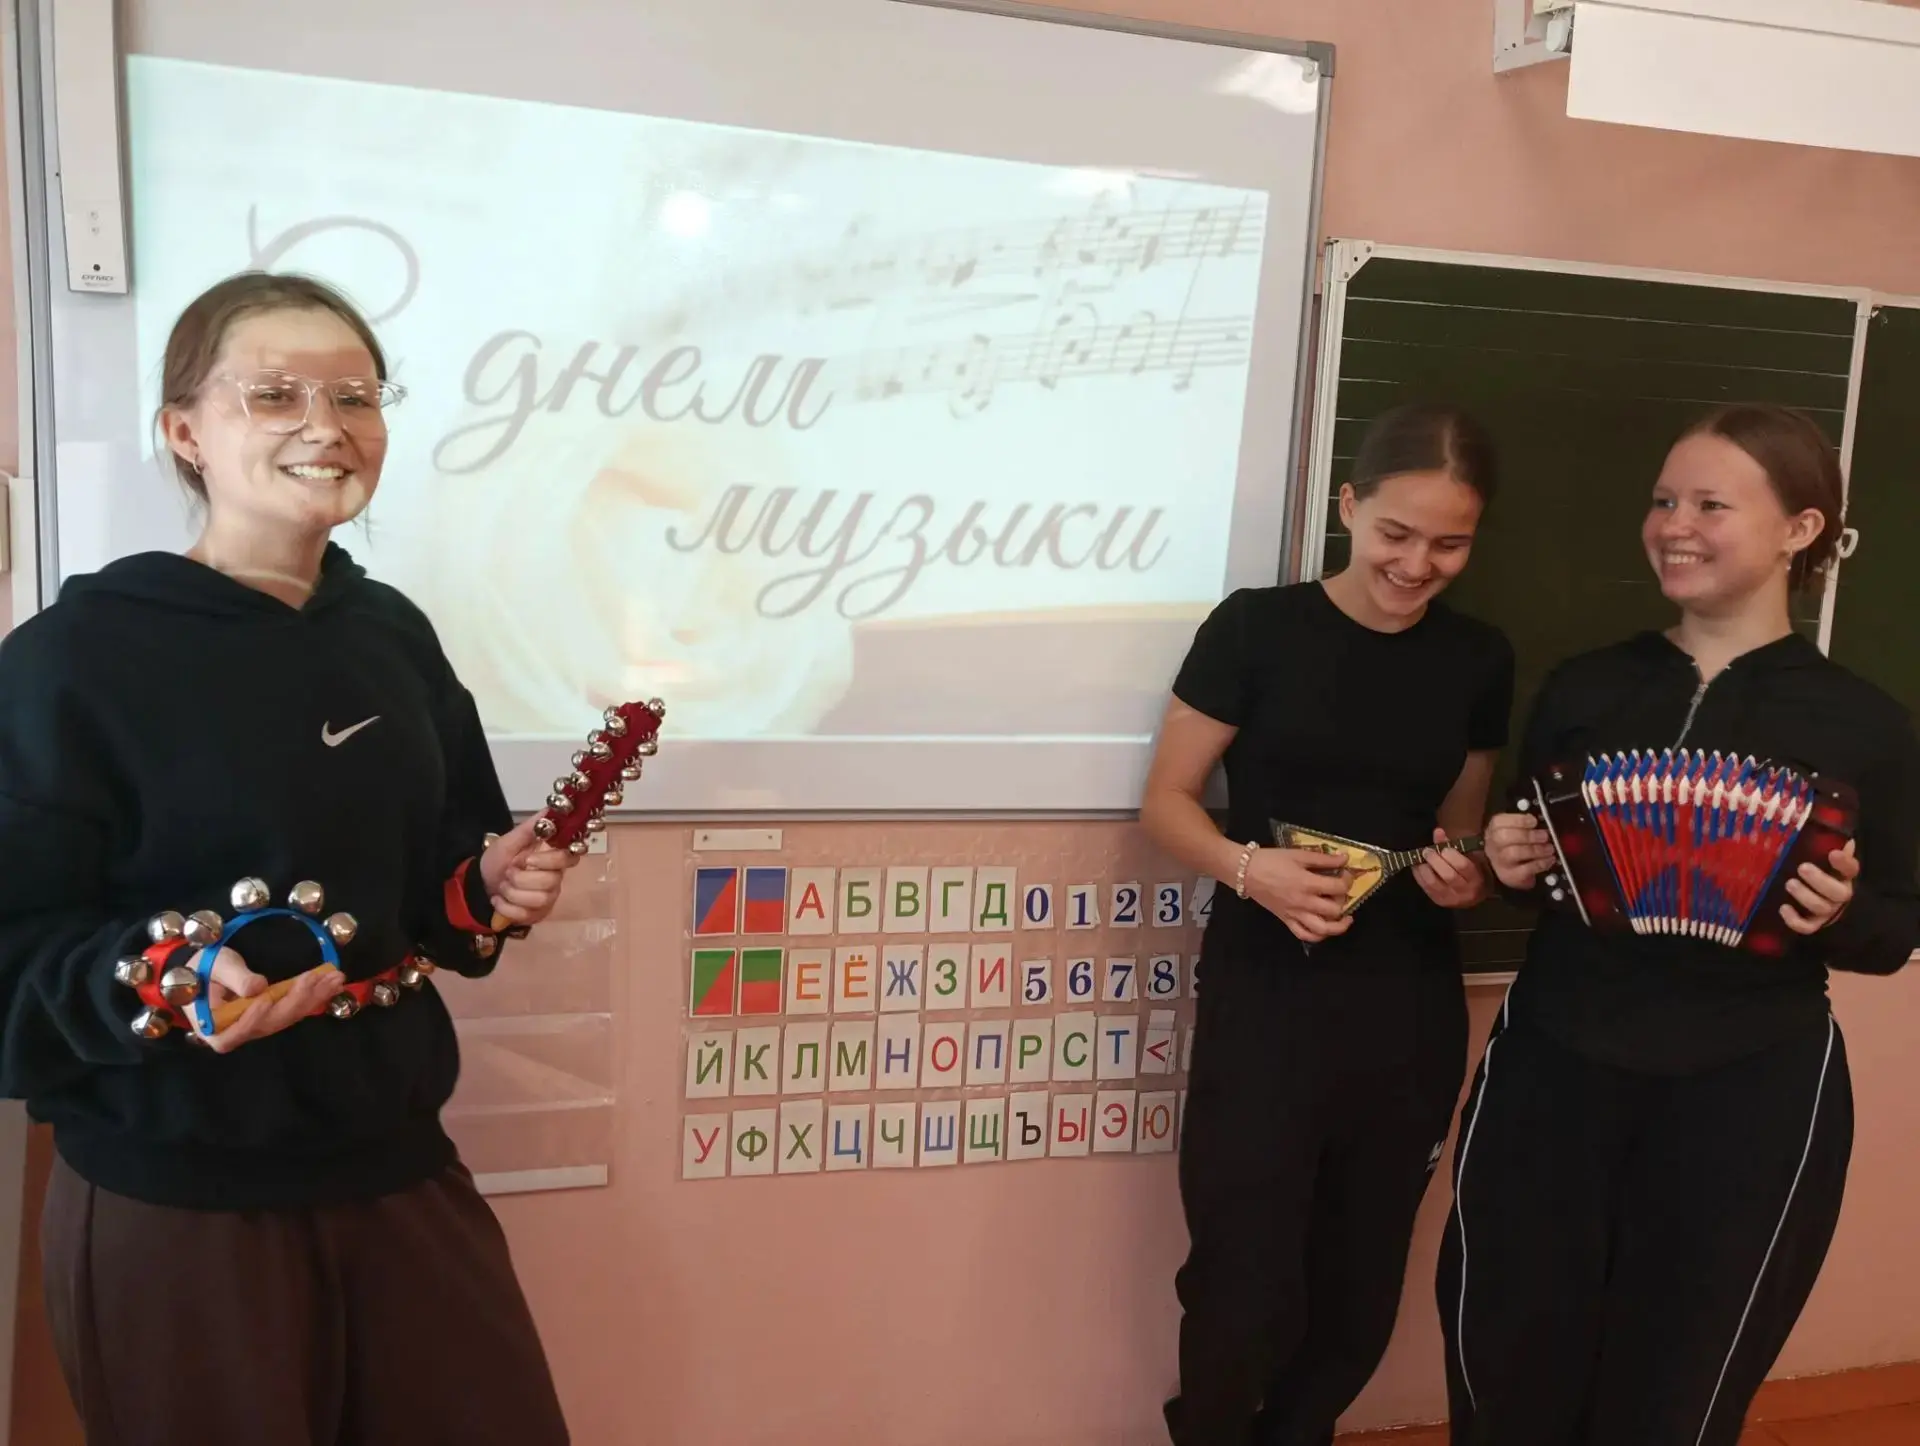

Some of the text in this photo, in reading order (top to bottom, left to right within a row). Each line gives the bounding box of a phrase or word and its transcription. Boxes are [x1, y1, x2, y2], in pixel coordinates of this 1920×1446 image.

[432, 329, 834, 474] днем
[664, 483, 1170, 620] музыки
[846, 882, 872, 918] Б
[941, 881, 964, 917] Г
[980, 883, 1008, 926] Д
[1025, 887, 1049, 922] 0
[1073, 892, 1091, 925] 1
[1116, 888, 1138, 922] 2
[1160, 888, 1180, 921] 3
[844, 955, 868, 998] Ё
[886, 960, 919, 996] Ж
[979, 956, 1005, 993] И
[1026, 966, 1047, 1000] 5
[1069, 962, 1091, 995] 6
[1110, 964, 1133, 998] 7
[1154, 961, 1176, 993] 8
[696, 1041, 722, 1084] Й
[792, 1042, 818, 1079] Л
[976, 1034, 1000, 1069] П
[736, 1127, 768, 1161] Ф
[834, 1120, 862, 1163] Ц
[880, 1119, 904, 1153] Ч
[924, 1115, 954, 1150] Ш
[969, 1115, 998, 1156] Щ
[1016, 1112, 1041, 1145] Ъ
[1058, 1108, 1086, 1142] Ы
[1103, 1103, 1127, 1138] Э
[1143, 1104, 1170, 1140] Ю
